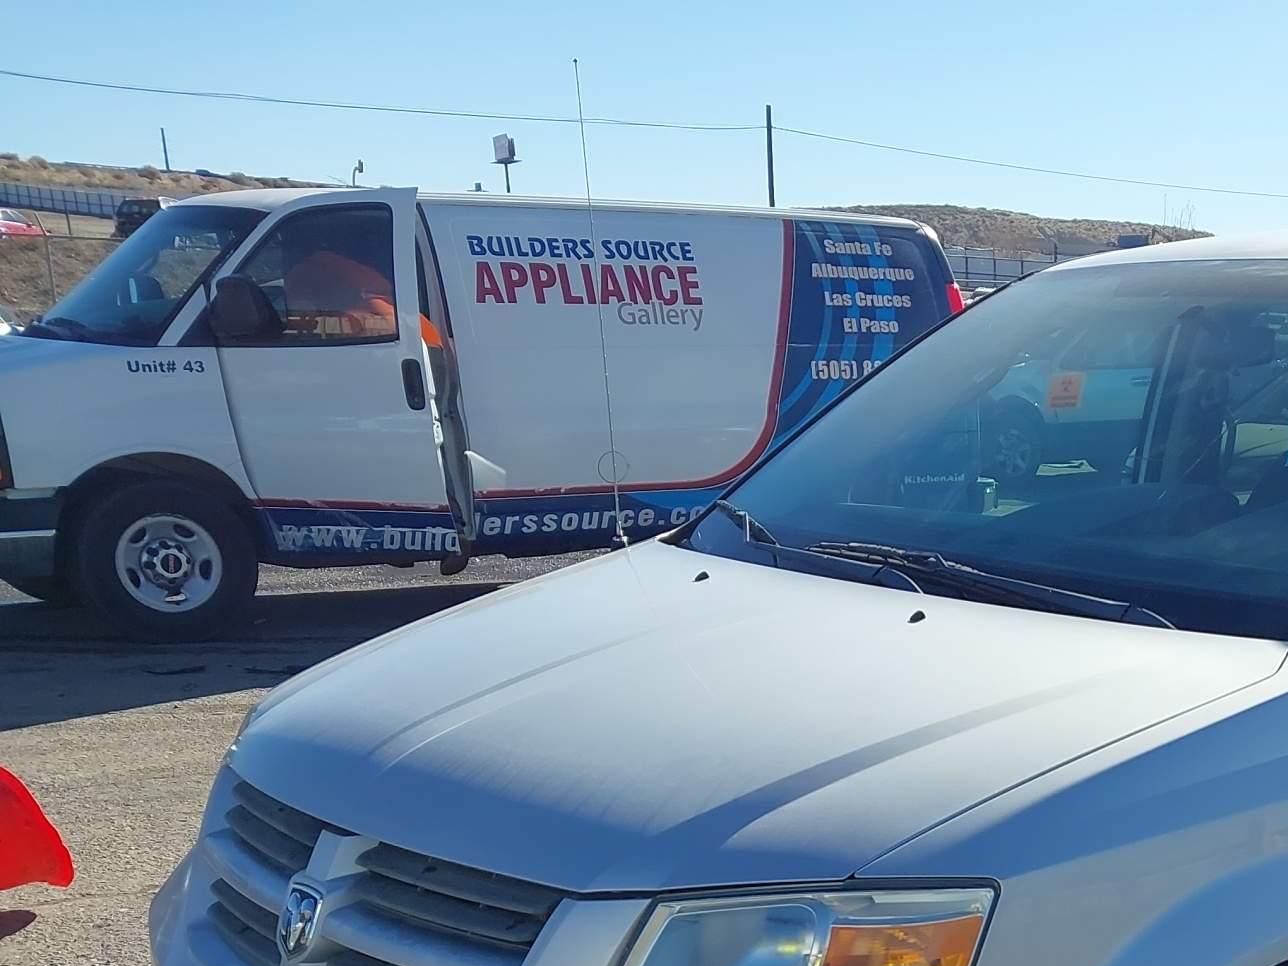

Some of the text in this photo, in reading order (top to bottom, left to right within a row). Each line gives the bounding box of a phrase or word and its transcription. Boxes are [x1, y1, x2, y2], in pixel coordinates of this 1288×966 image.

[466, 235, 694, 262] BUILDERS SOURCE
[824, 239, 893, 256] Santa Fe
[811, 263, 915, 281] Albuquerque
[474, 261, 703, 306] APPLIANCE
[824, 291, 912, 307] Las Cruces
[617, 302, 704, 331] Gallery
[843, 318, 899, 333] El Paso
[127, 360, 205, 373] Unit# 43
[810, 360, 858, 380] (505)
[904, 473, 965, 485] KitchenAid
